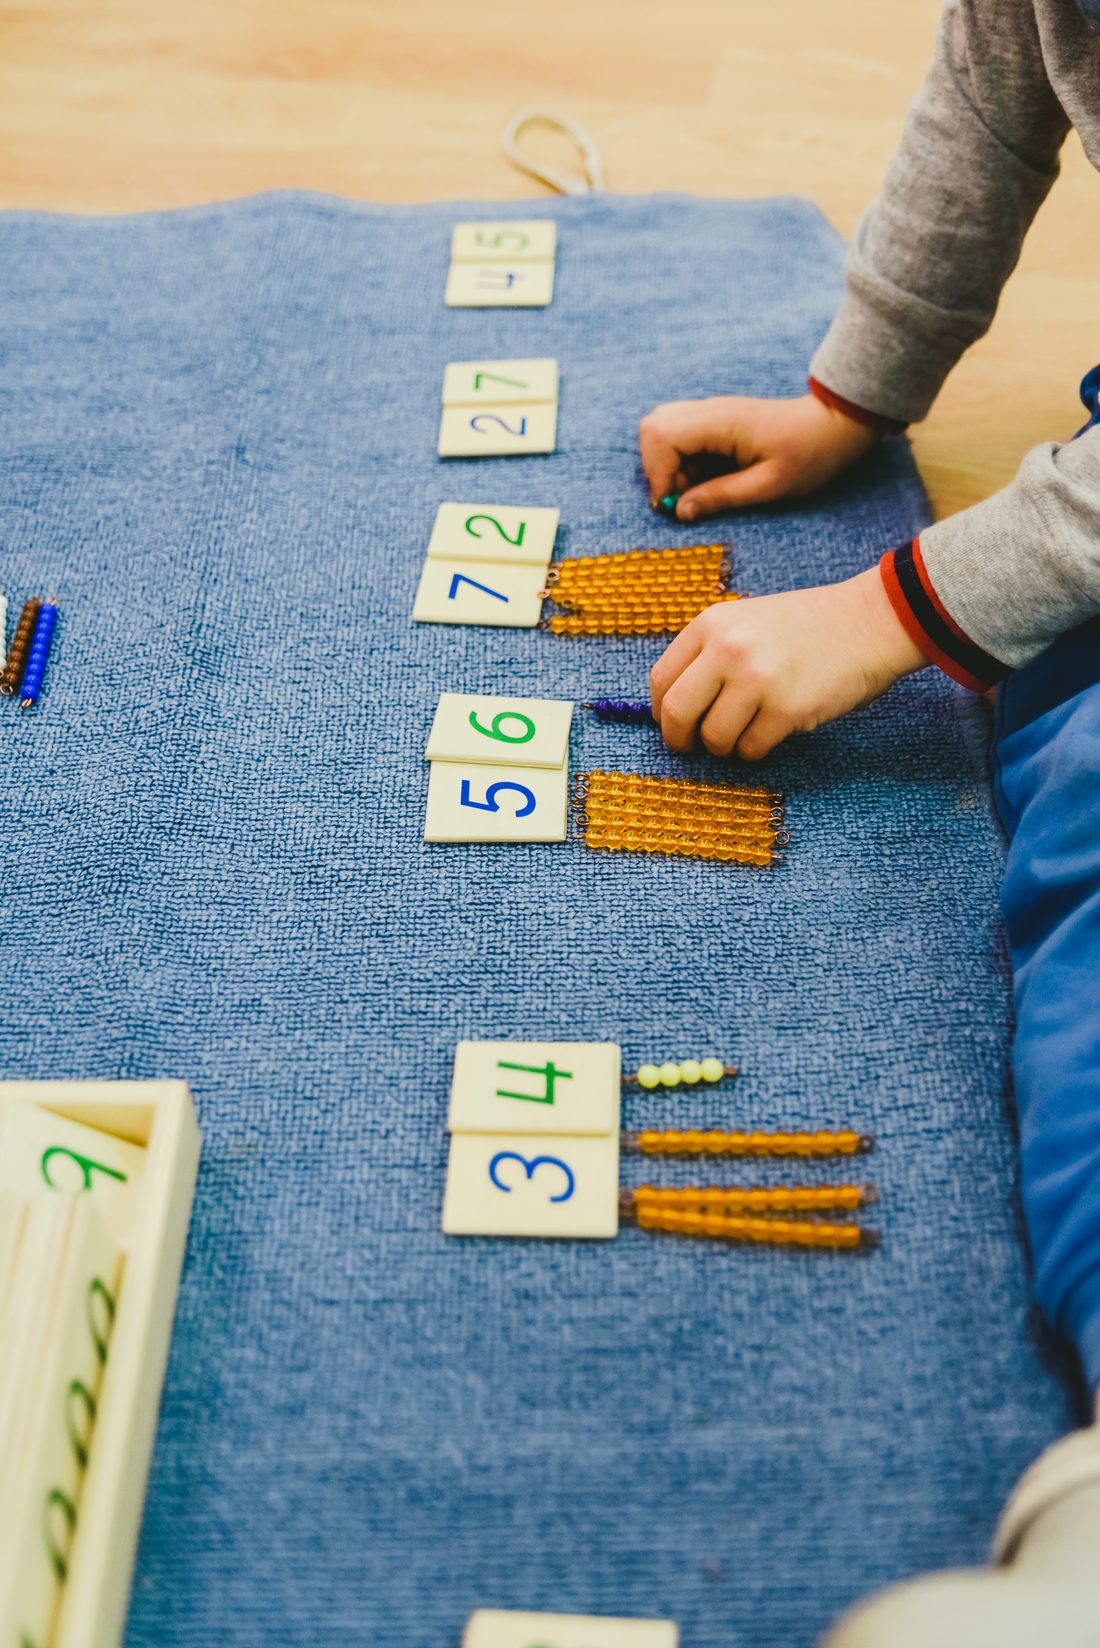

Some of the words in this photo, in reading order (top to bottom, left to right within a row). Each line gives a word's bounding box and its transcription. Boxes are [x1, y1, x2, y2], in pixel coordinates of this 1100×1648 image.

[474, 229, 530, 251] 5
[473, 371, 529, 391] 7
[469, 413, 527, 437] 2
[464, 514, 527, 547] 2
[447, 573, 511, 604] 7
[468, 710, 537, 745] 6
[459, 779, 537, 818] 5
[495, 1061, 574, 1106] 4
[488, 1150, 576, 1204] 3
